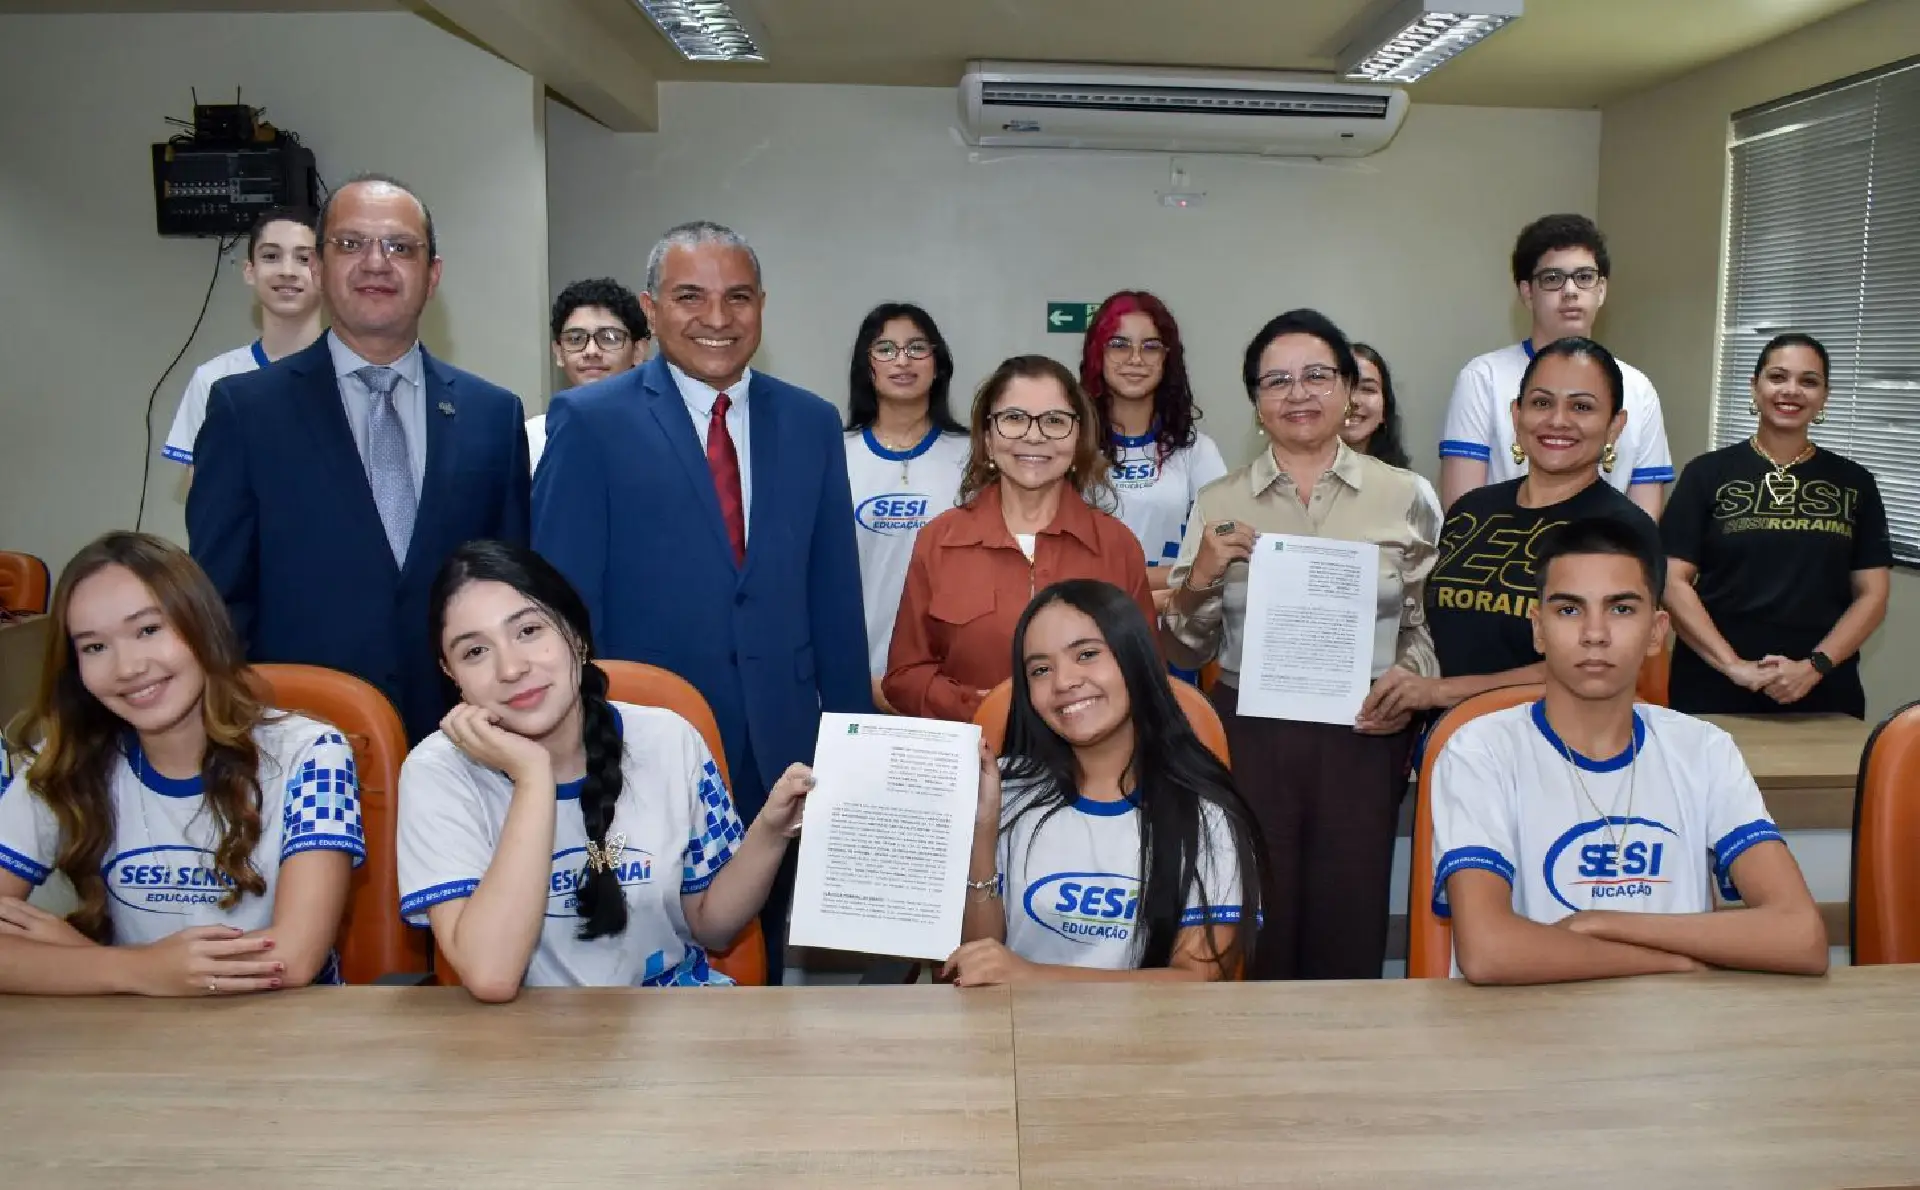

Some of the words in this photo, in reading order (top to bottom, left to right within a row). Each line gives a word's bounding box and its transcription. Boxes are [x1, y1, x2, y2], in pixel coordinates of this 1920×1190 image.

[1578, 841, 1664, 877] SESI
[145, 893, 218, 905] EDUCAÇÃO
[1062, 921, 1129, 940] EDUCAÇÃO
